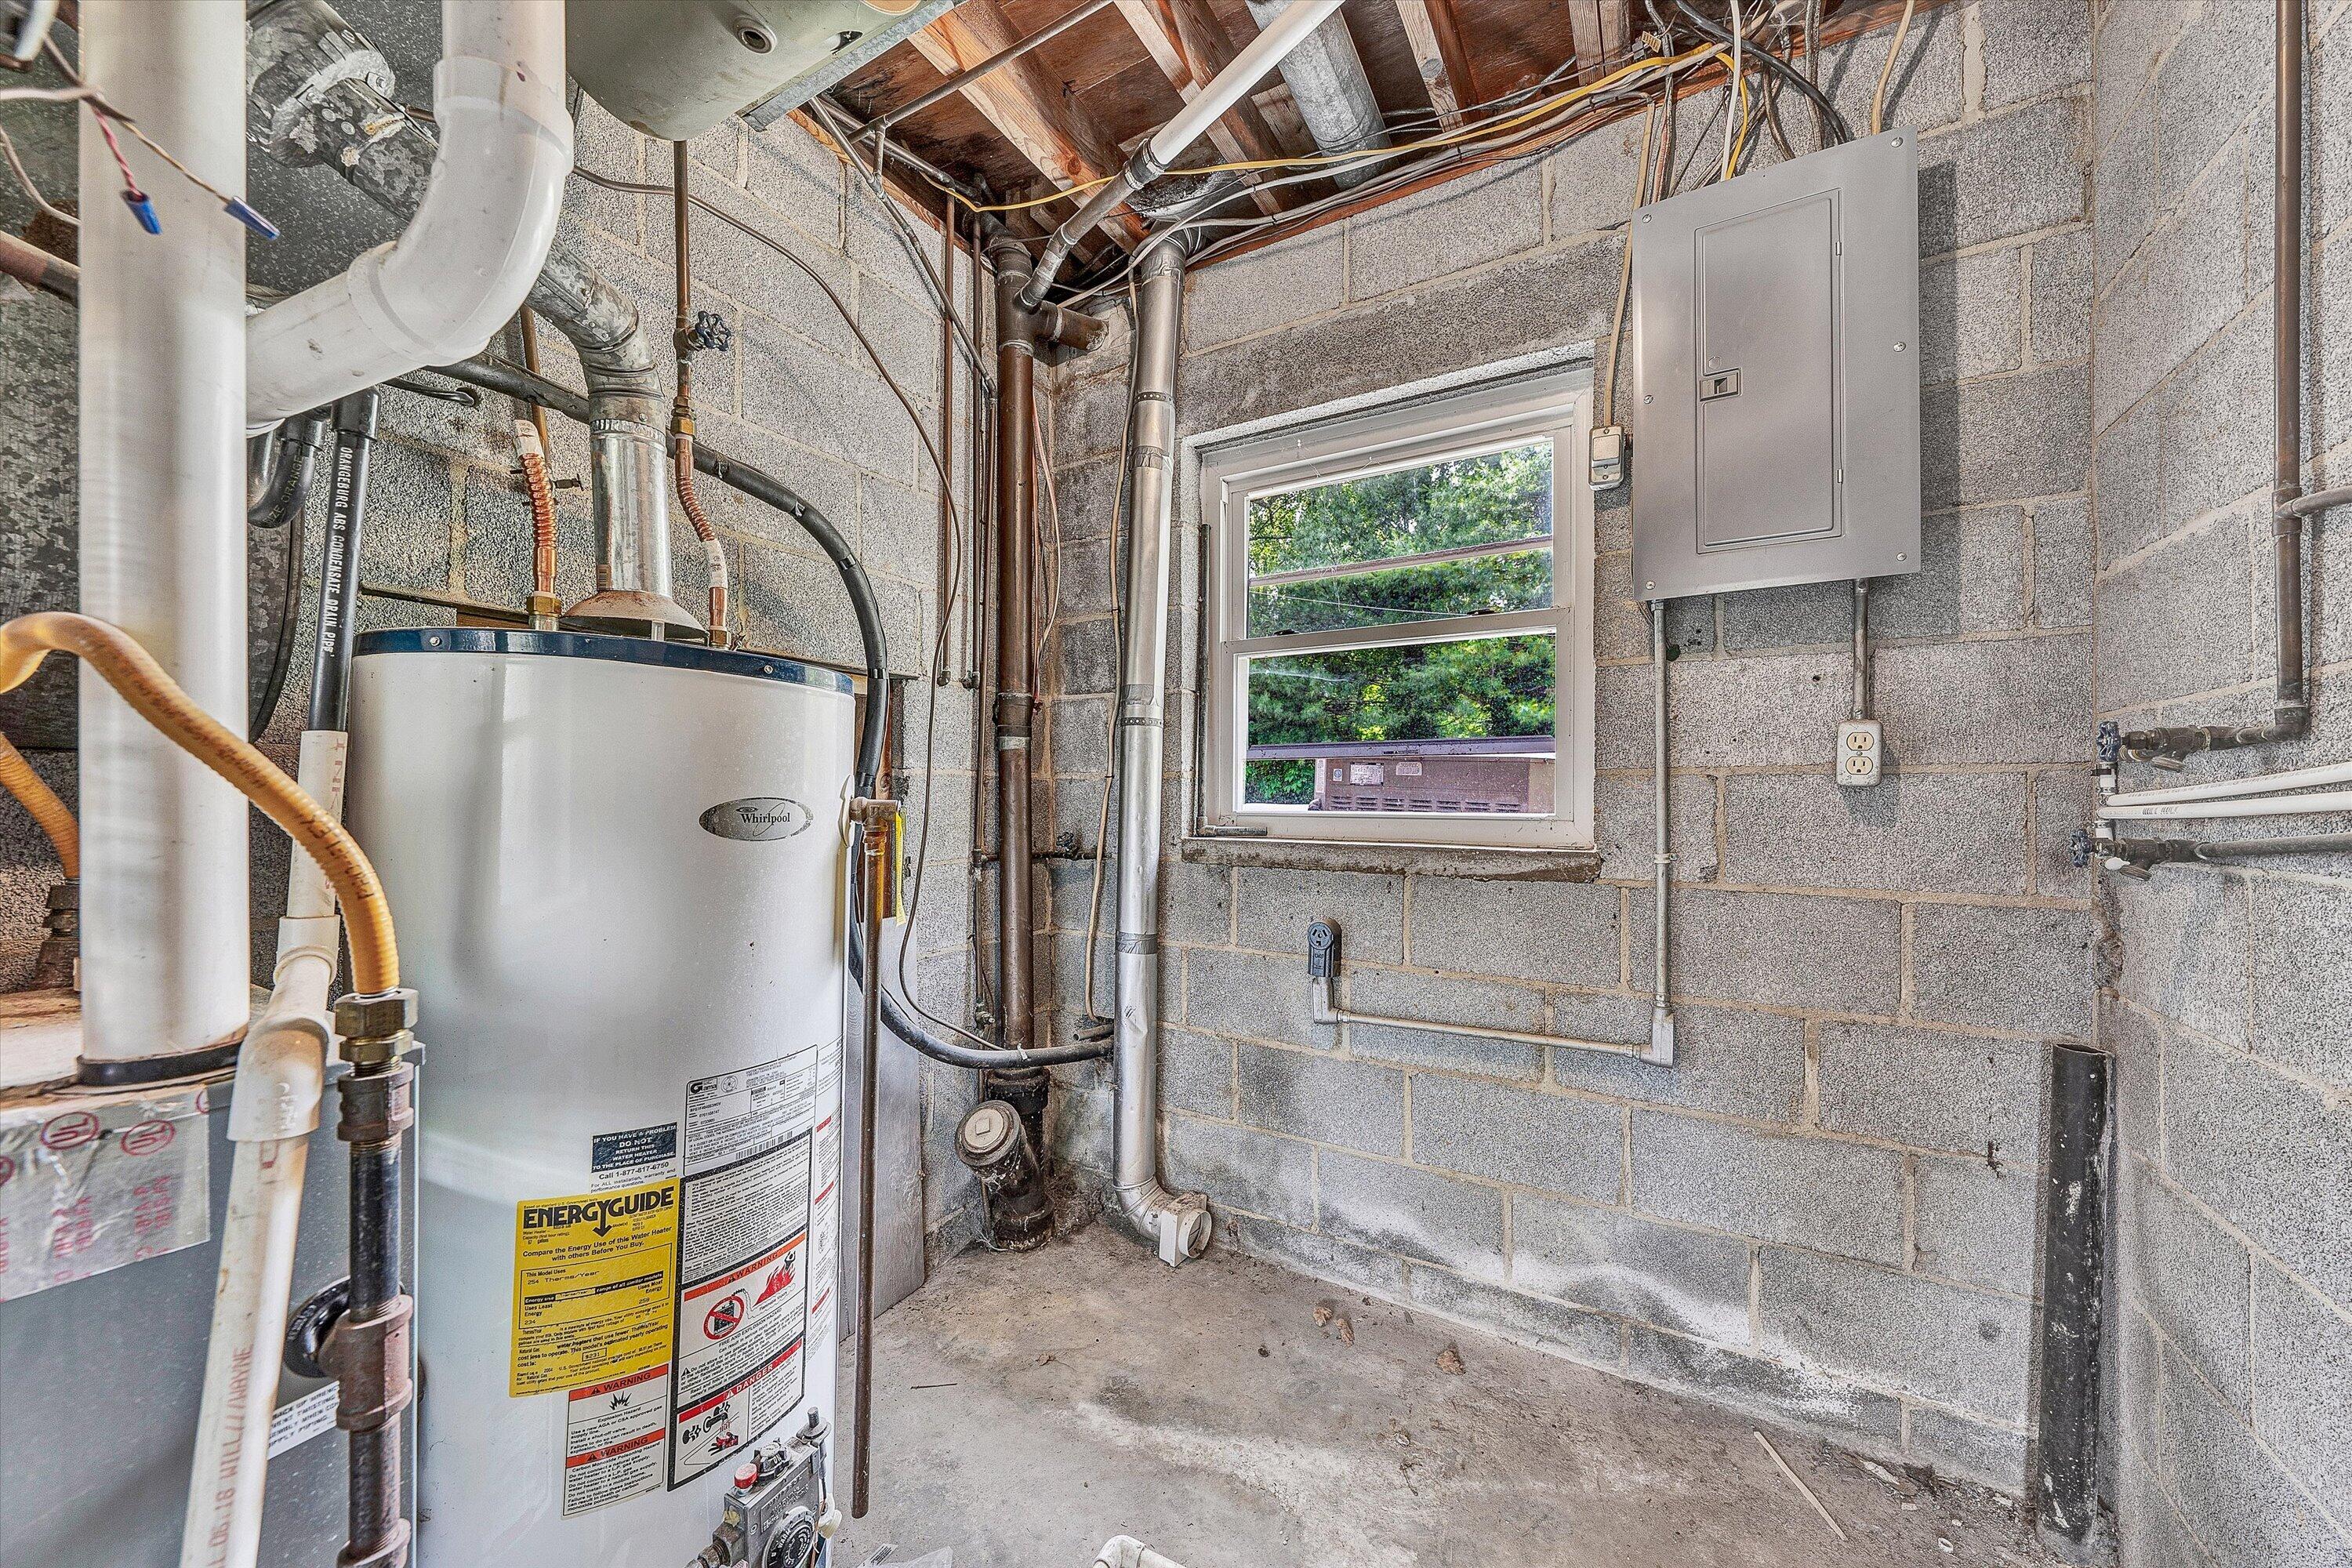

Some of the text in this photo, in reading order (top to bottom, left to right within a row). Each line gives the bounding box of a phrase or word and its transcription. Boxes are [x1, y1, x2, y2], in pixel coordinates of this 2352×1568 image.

[335, 447, 353, 508] ORANGEBURG
[333, 512, 347, 531] ABS
[328, 536, 344, 594] CONDENSATE
[325, 599, 339, 626] DRAIN
[741, 811, 791, 827] Whirlpool
[645, 1125, 676, 1135] PROBLEM
[616, 1162, 669, 1176] 1-877-817-6750
[591, 1185, 620, 1193] performance
[524, 1186, 674, 1237] ENERGYGUIDE
[631, 1232, 650, 1241] Water
[652, 1226, 673, 1235] Heater
[734, 1254, 780, 1278] WARNING
[644, 1272, 662, 1282] models
[604, 1335, 628, 1345] estimated
[645, 1324, 668, 1334] operating
[742, 1318, 766, 1336] EXPLOSION
[604, 1373, 651, 1391] WARNING
[737, 1364, 773, 1392] DANGER
[597, 1407, 641, 1423] Explosion Hazard
[630, 1410, 652, 1419] approved
[592, 1430, 612, 1439] shut-off
[720, 1421, 731, 1432] HOT
[593, 1458, 616, 1468] Monoxide
[618, 1450, 642, 1460] Poisoning
[644, 1442, 660, 1452] Hazard
[601, 1437, 648, 1457] WARNING
[633, 1455, 650, 1464] supply.
